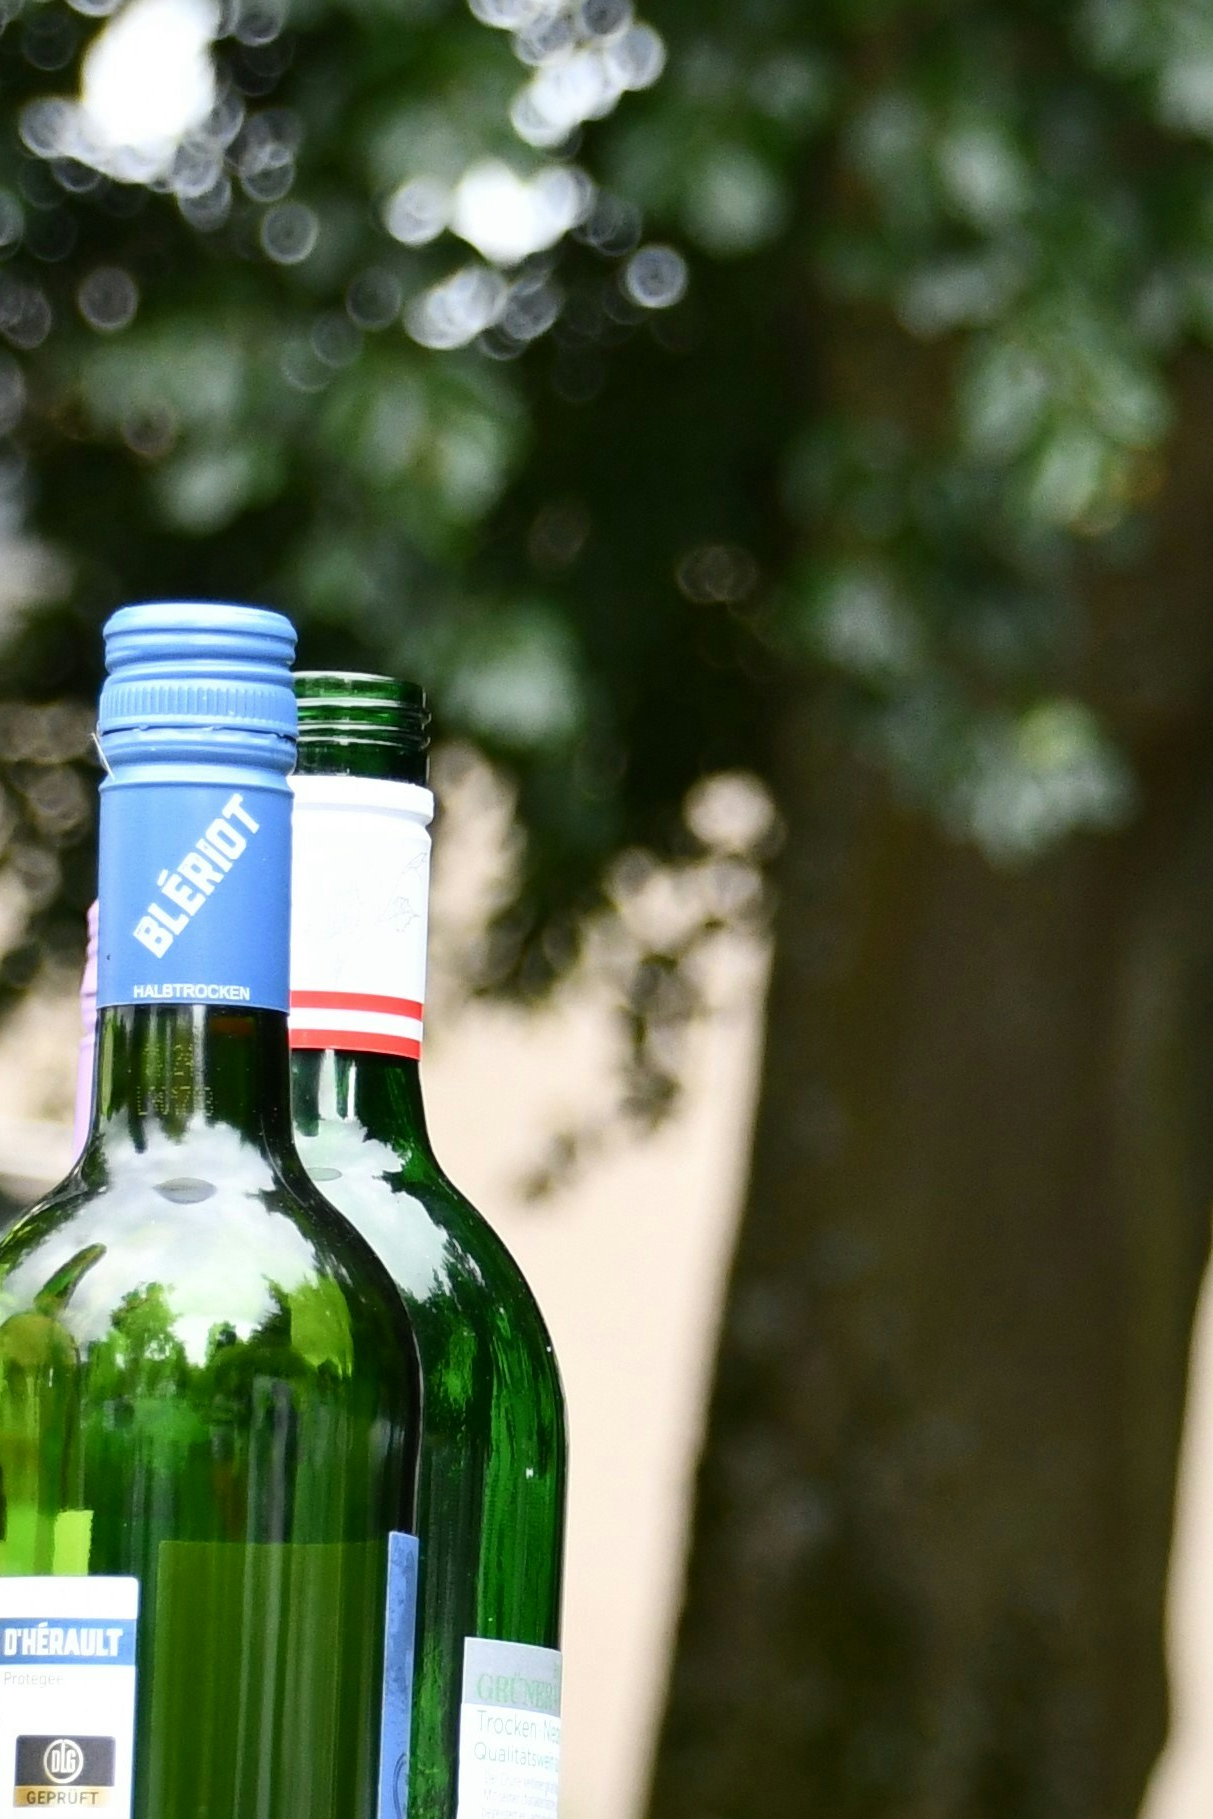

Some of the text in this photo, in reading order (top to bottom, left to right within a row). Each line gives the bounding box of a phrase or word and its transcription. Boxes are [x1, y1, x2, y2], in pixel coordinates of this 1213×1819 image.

[132, 793, 260, 960] BLÉRIOT
[133, 983, 250, 1001] HALBTROCKEN
[4, 1621, 123, 1657] D'HÉRAULT
[476, 1709, 536, 1739] Trocken
[51, 1741, 76, 1773] DLG
[26, 1788, 99, 1805] GEPRÜFT
